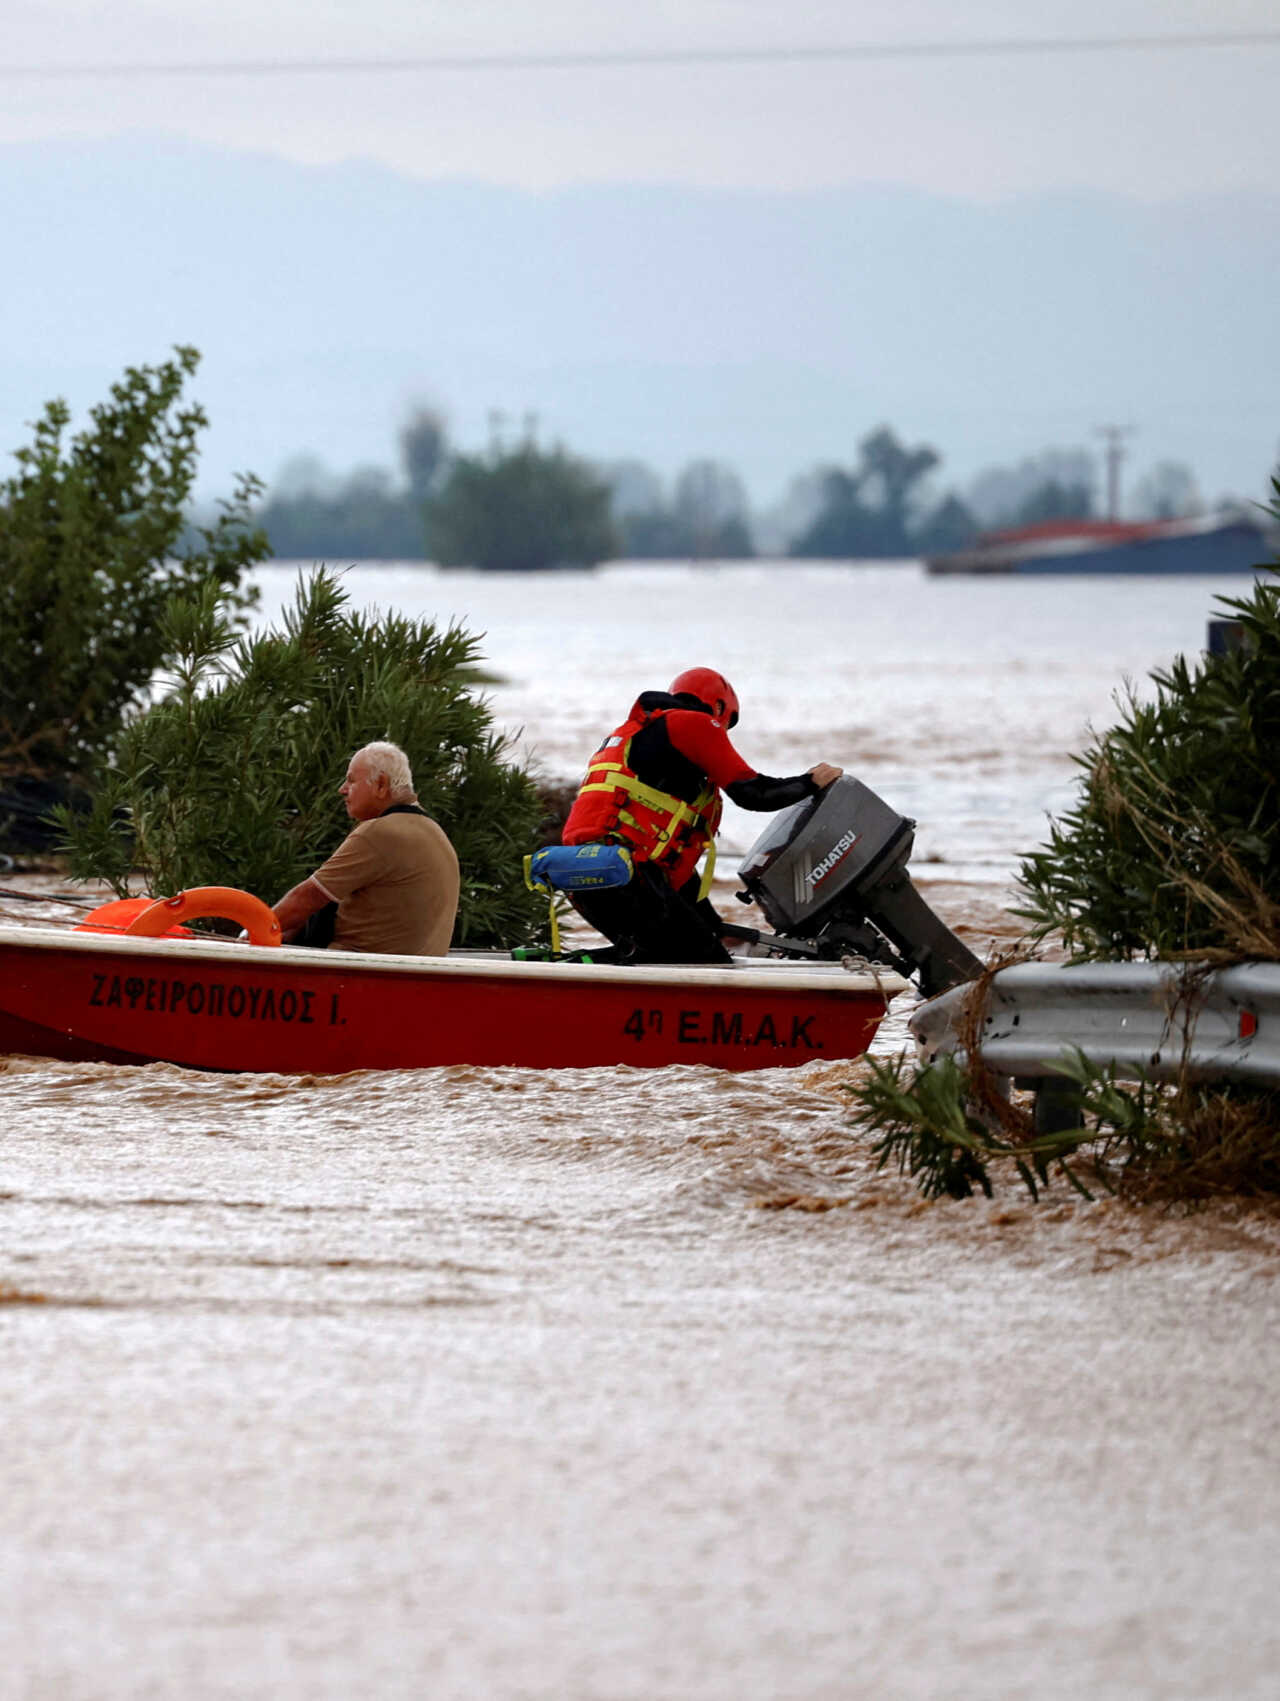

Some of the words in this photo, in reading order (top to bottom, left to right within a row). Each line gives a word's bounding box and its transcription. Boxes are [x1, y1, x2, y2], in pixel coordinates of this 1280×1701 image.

[805, 830, 857, 885] TOHATSU
[89, 973, 315, 1023] ΖΑΦΕΙΡΟΠΟΥΛΟΣ
[677, 1010, 824, 1049] Ε.Μ.Α.Κ.
